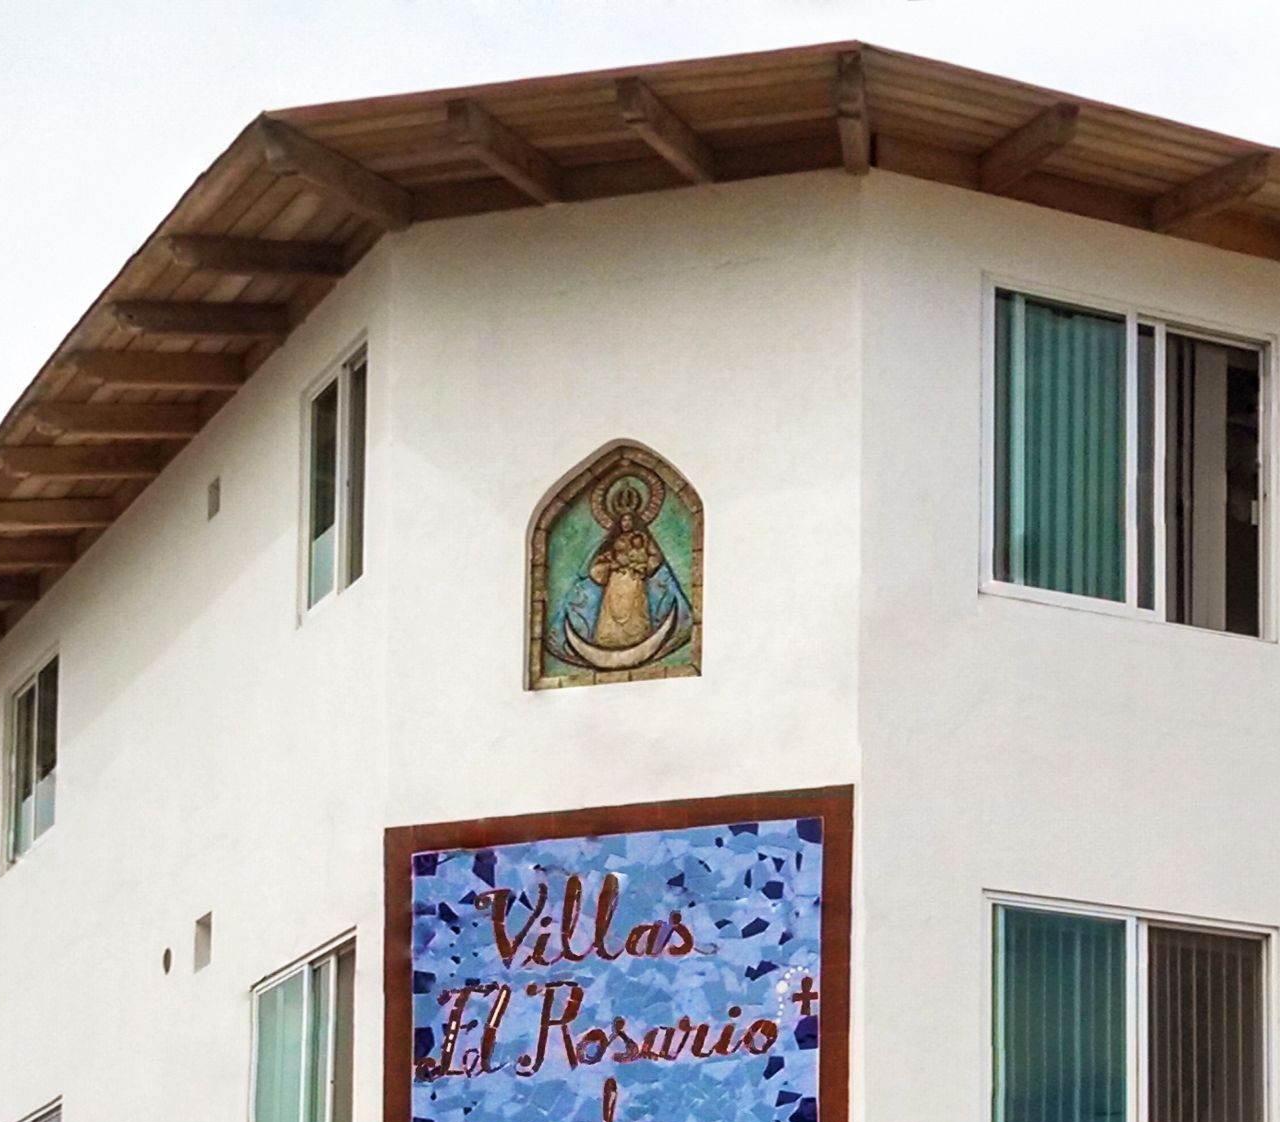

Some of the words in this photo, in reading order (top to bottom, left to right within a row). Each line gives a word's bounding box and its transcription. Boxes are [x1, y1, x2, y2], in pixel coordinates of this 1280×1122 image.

[475, 873, 718, 969] Villas
[414, 981, 510, 1081] El
[515, 980, 780, 1076] Rosario
